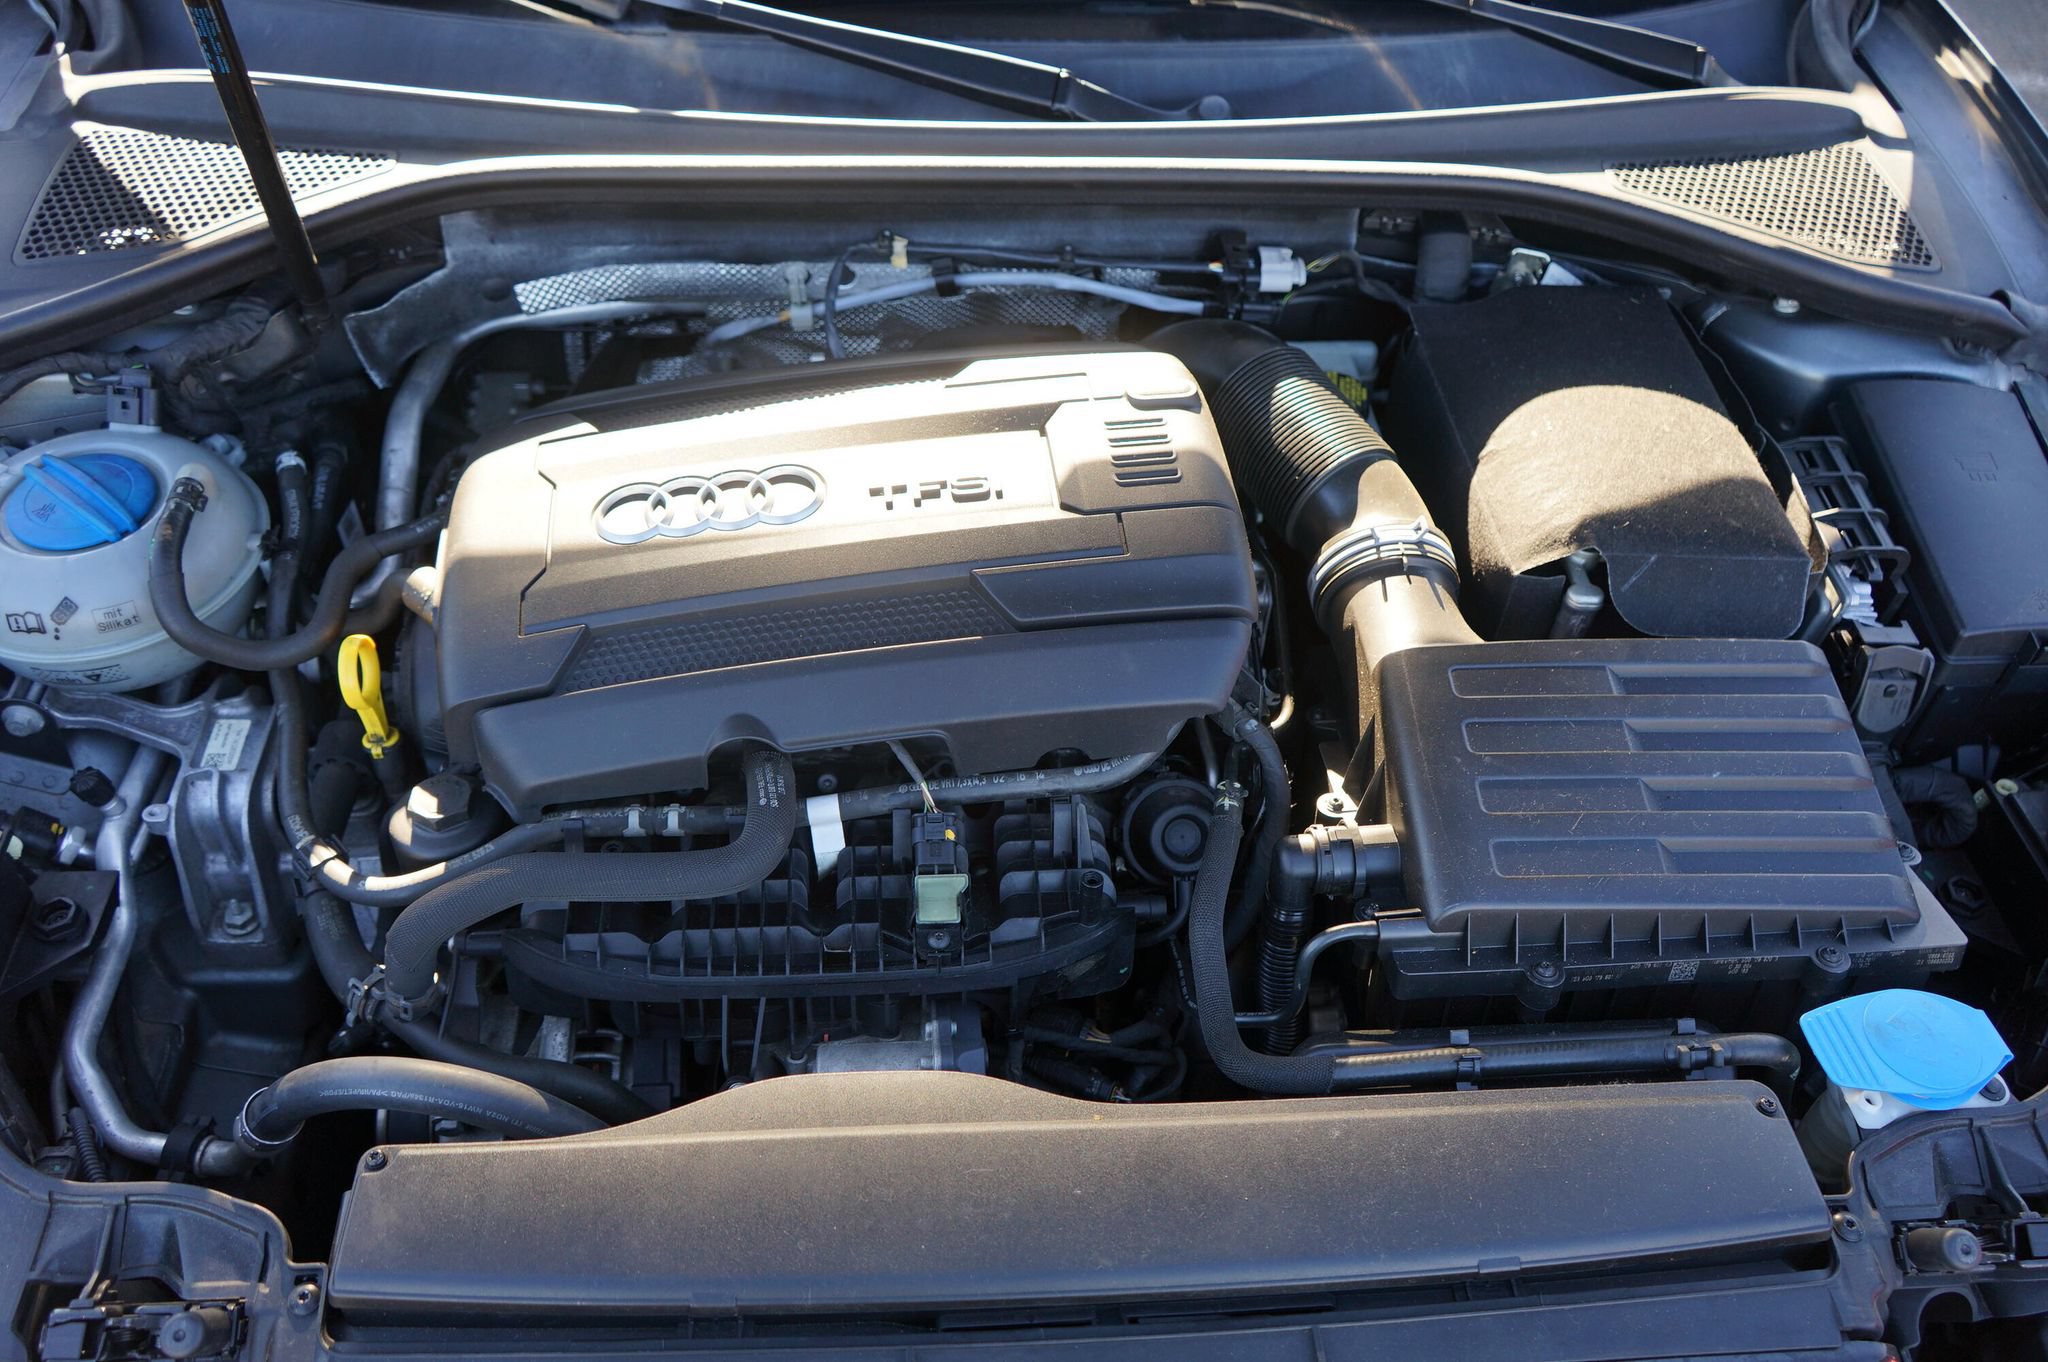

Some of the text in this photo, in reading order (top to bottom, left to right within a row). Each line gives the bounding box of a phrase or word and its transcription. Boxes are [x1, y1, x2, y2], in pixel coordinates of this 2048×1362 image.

[868, 476, 1004, 511] TFS
[103, 607, 123, 620] mit
[97, 615, 140, 632] Silikat
